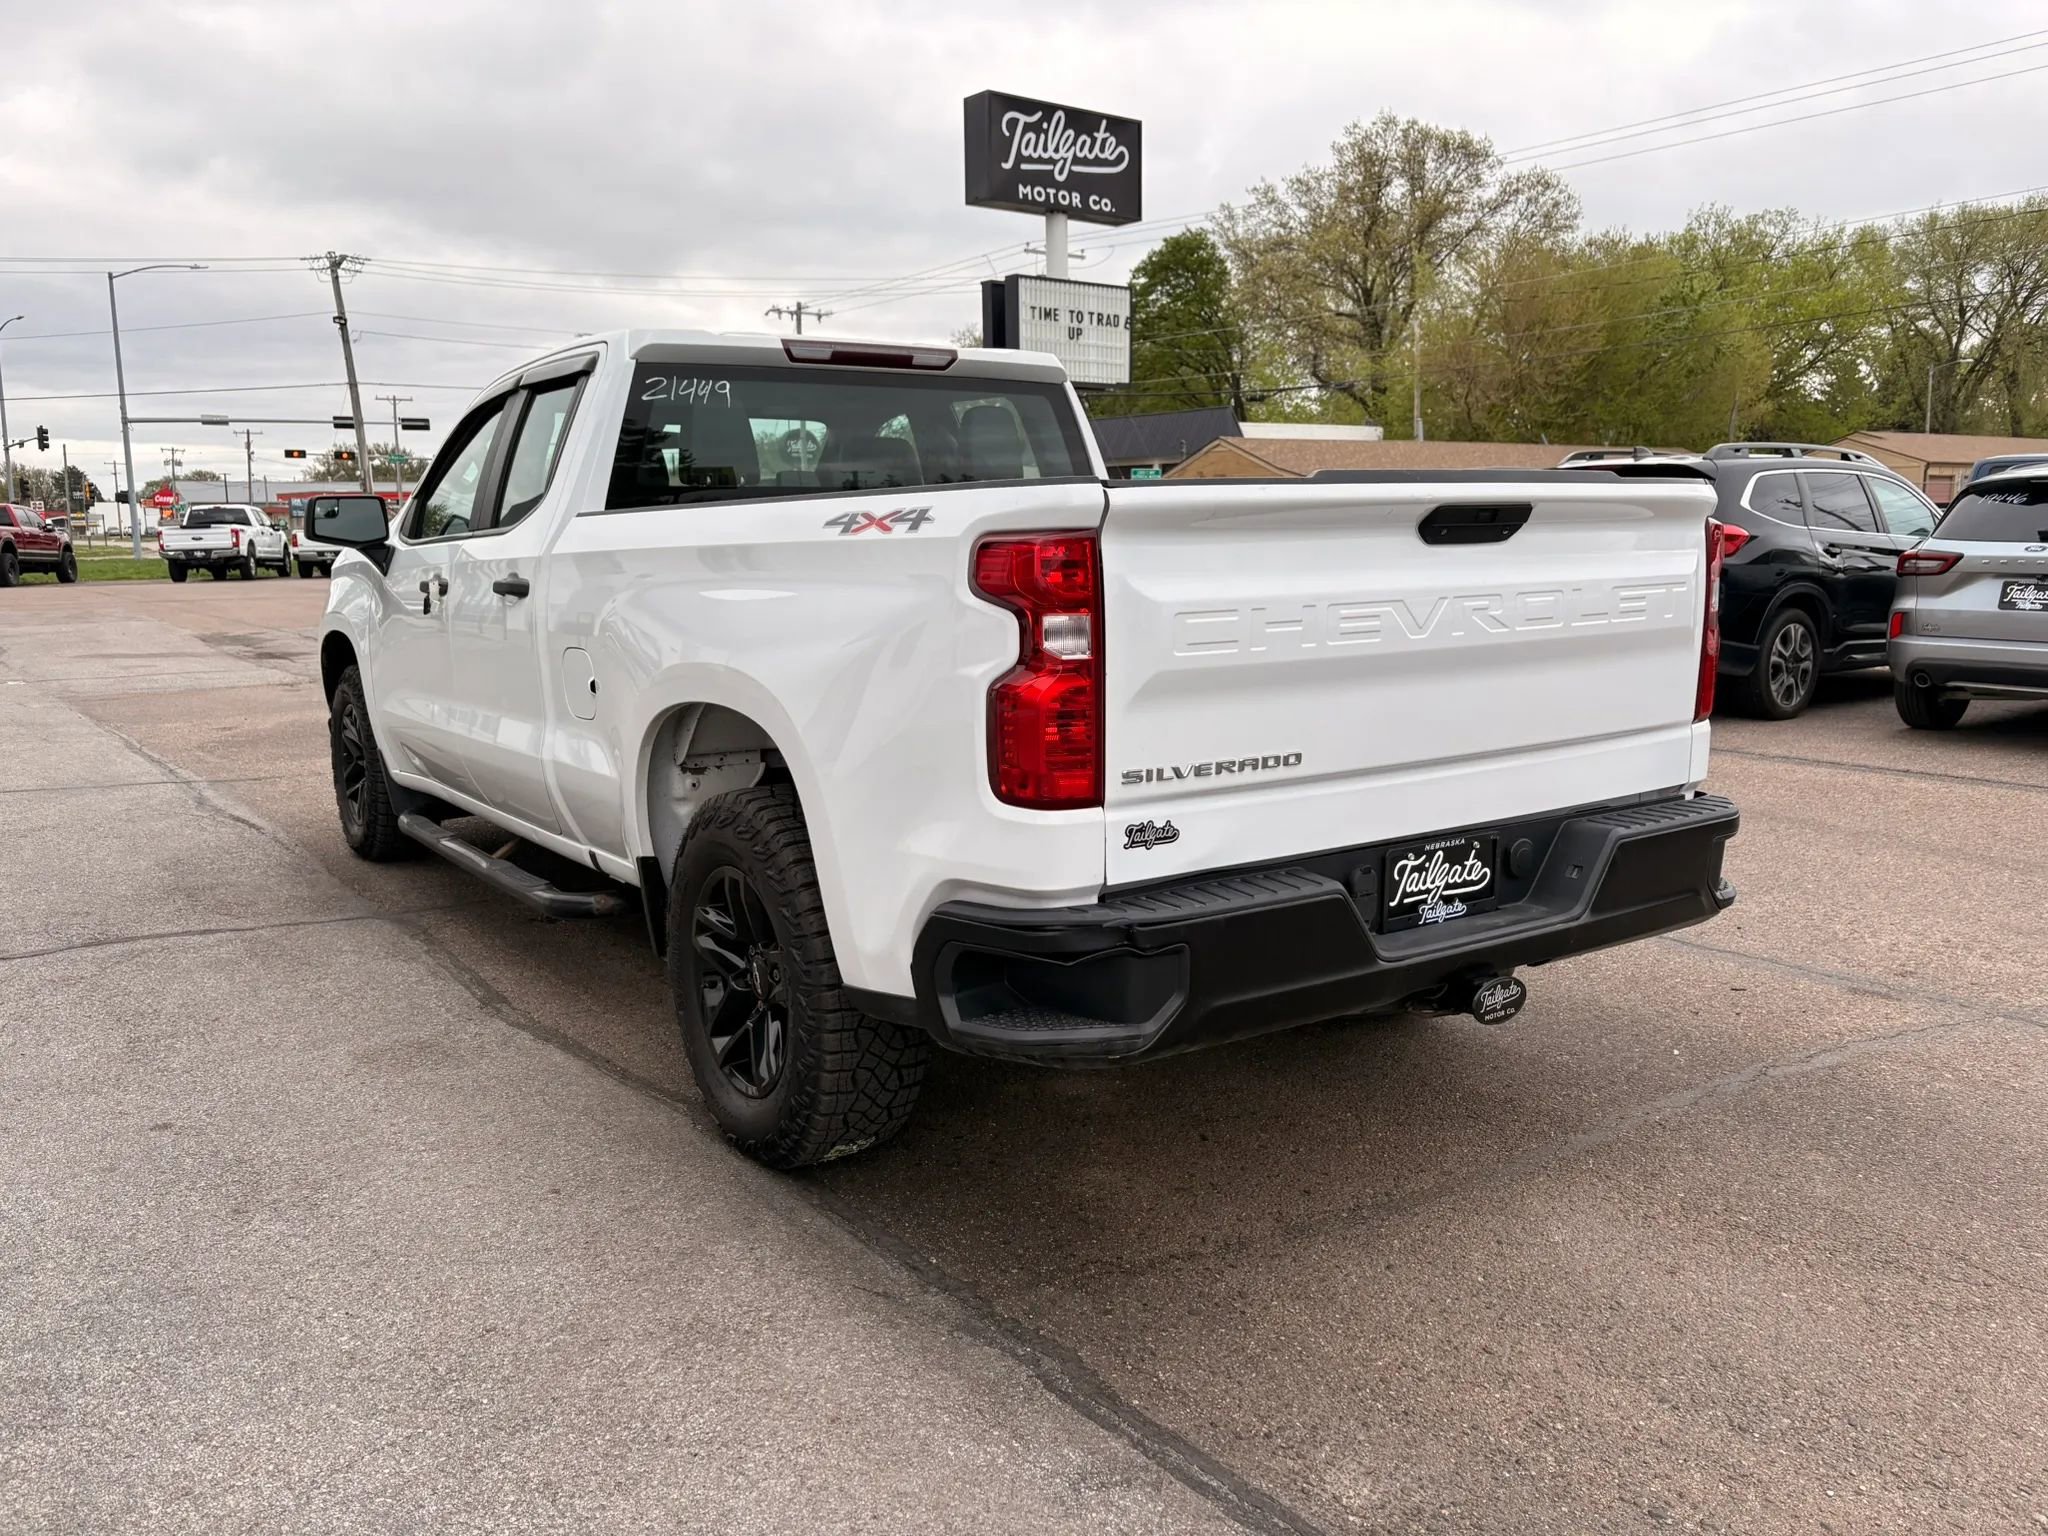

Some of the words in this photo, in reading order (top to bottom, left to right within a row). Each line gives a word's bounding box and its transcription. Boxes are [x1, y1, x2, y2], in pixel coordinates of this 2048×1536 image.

[1001, 110, 1130, 182] Tailgate
[1018, 183, 1082, 208] MOTOR
[1030, 305, 1060, 322] TIME
[1069, 309, 1084, 324] TO
[1068, 326, 1083, 341] UP
[641, 375, 731, 409] 21449
[2003, 584, 2048, 604] Tailga
[1173, 581, 1689, 656] CHEVROLET
[1121, 752, 1302, 785] SILVERADO
[1123, 820, 1180, 850] Tailgate
[1424, 838, 1465, 852] NEBRASKA
[1389, 849, 1491, 907] Tailgate
[1418, 898, 1467, 924] Tailgate
[1480, 980, 1521, 1014] Tailgate
[1484, 1010, 1505, 1021] MOTOR
